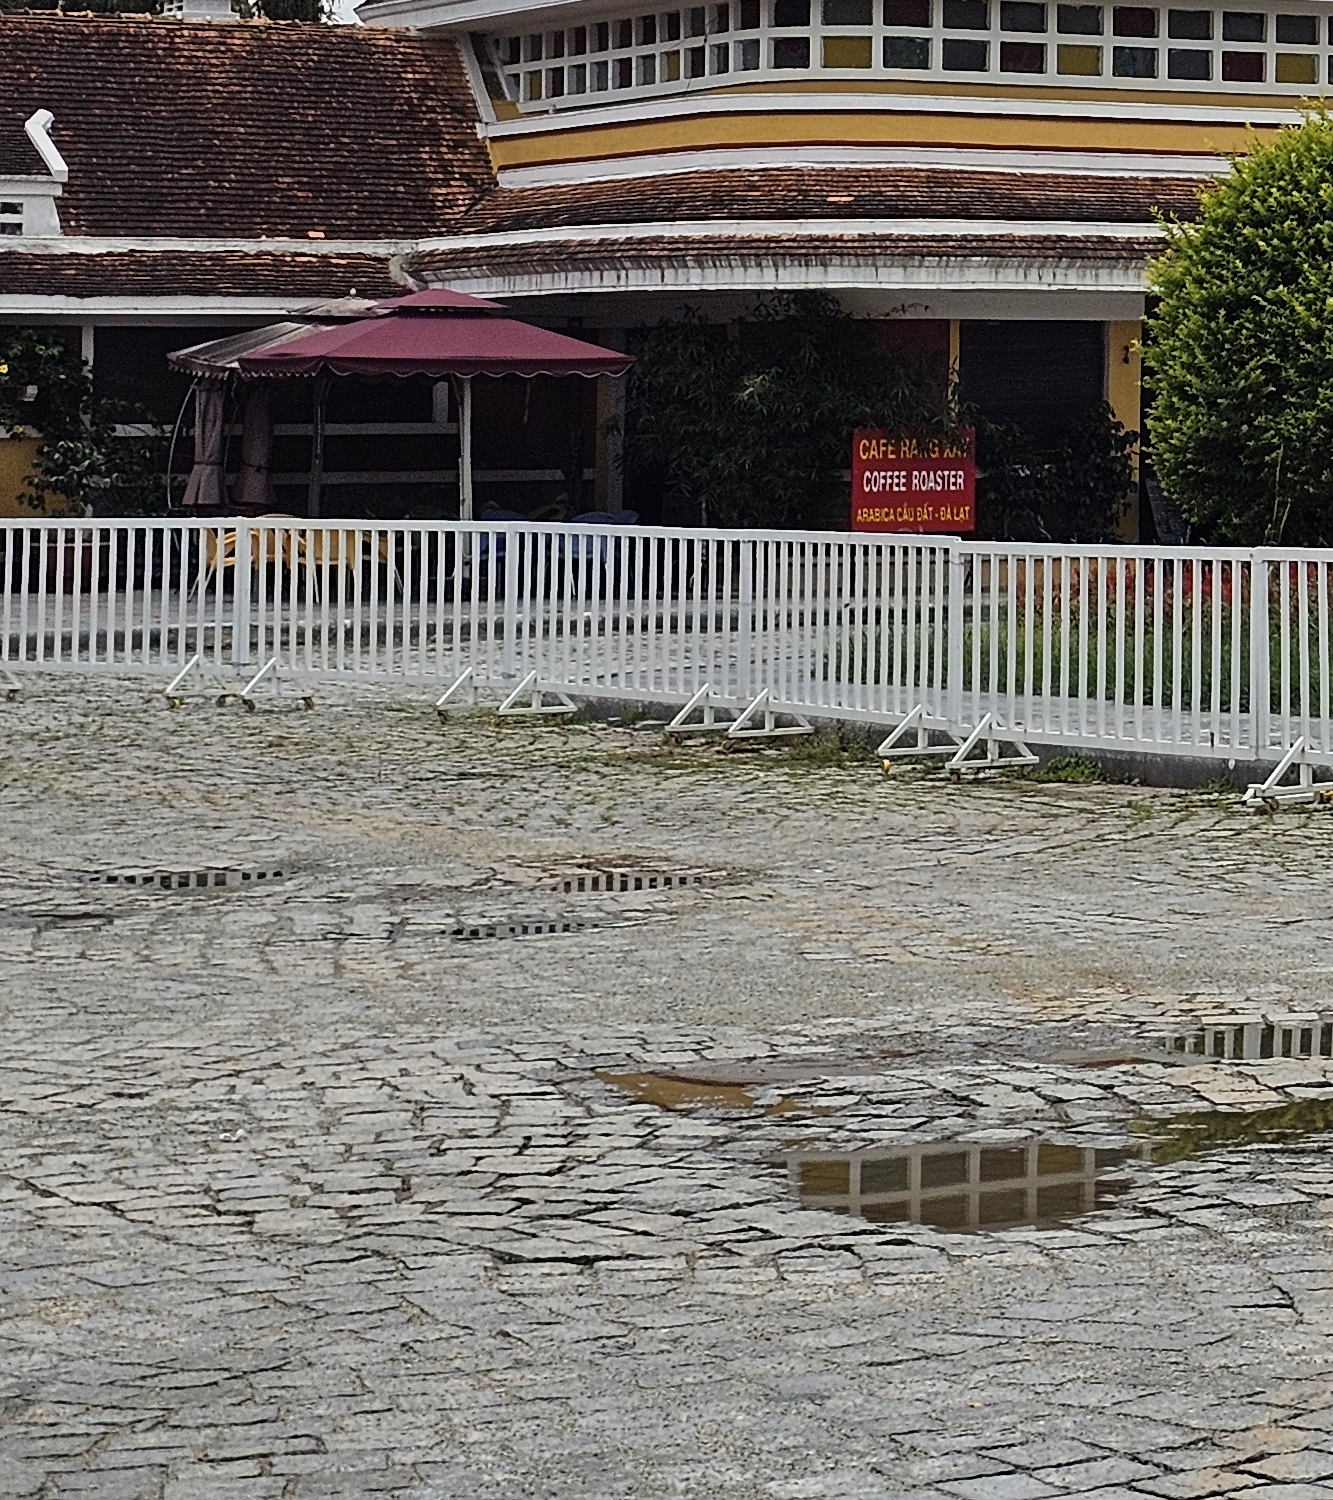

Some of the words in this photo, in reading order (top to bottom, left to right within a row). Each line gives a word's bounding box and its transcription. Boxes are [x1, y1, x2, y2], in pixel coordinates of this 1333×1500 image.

[863, 470, 907, 492] COFFEE
[911, 470, 965, 492] ROASTER
[856, 506, 895, 522] ARABICA
